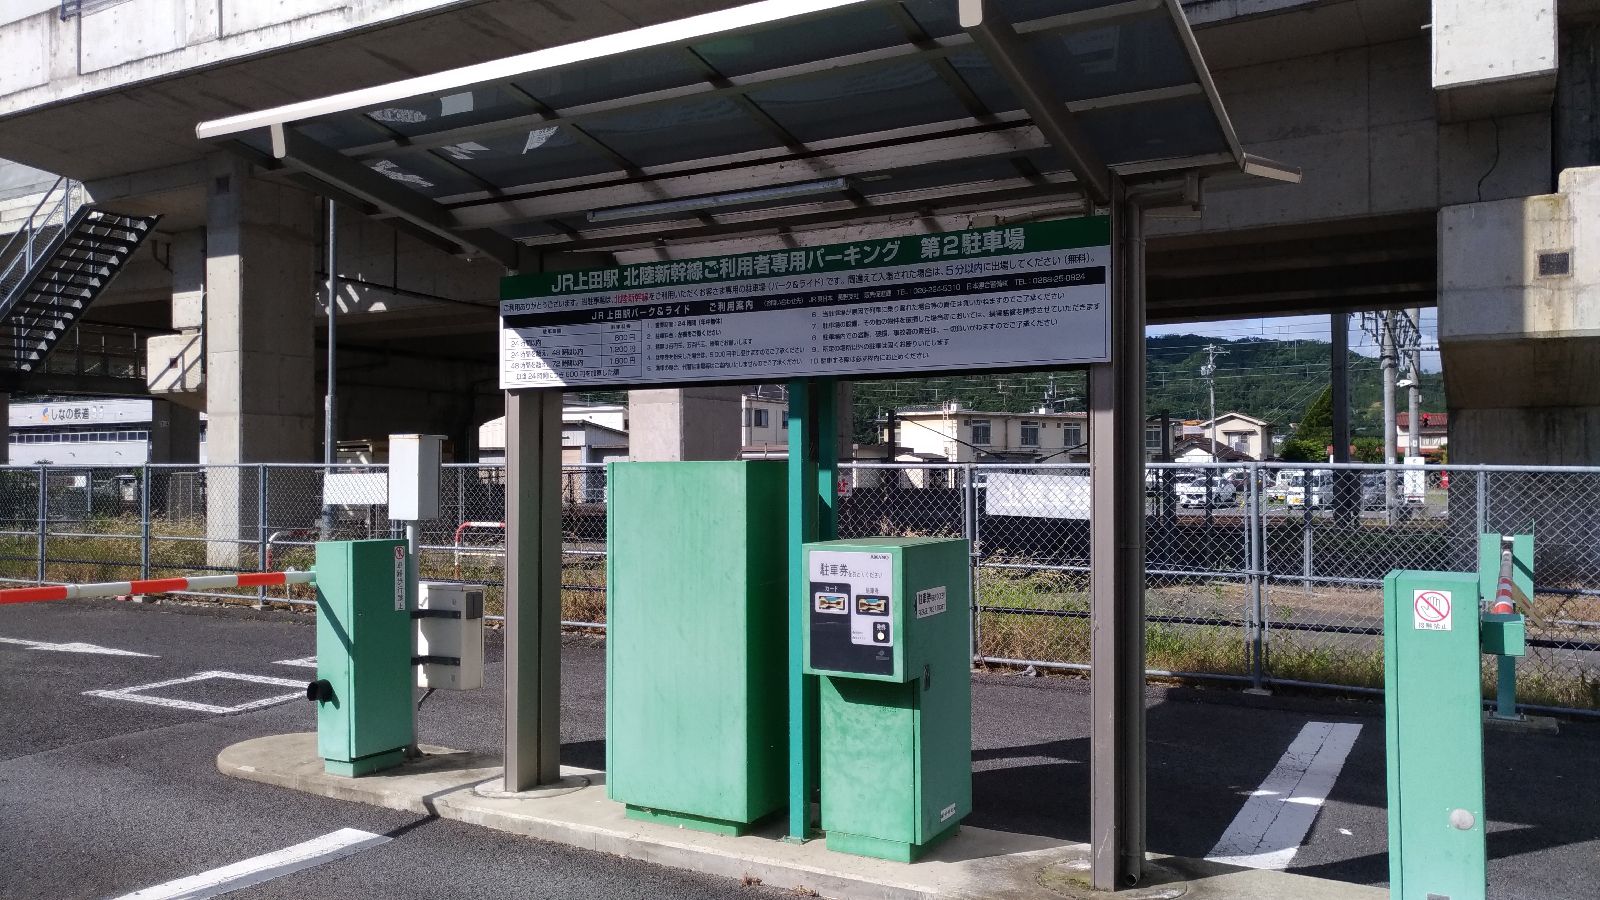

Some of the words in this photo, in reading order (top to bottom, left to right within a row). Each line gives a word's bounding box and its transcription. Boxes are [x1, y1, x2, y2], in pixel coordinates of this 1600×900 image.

[551, 268, 619, 293] JR上田駅
[623, 240, 901, 286] 北陸新幹線ご利用者専用パーキング
[920, 227, 1026, 259] 第2駐車場
[709, 300, 754, 313] ご利用案内
[51, 407, 90, 421] しなの鉄道
